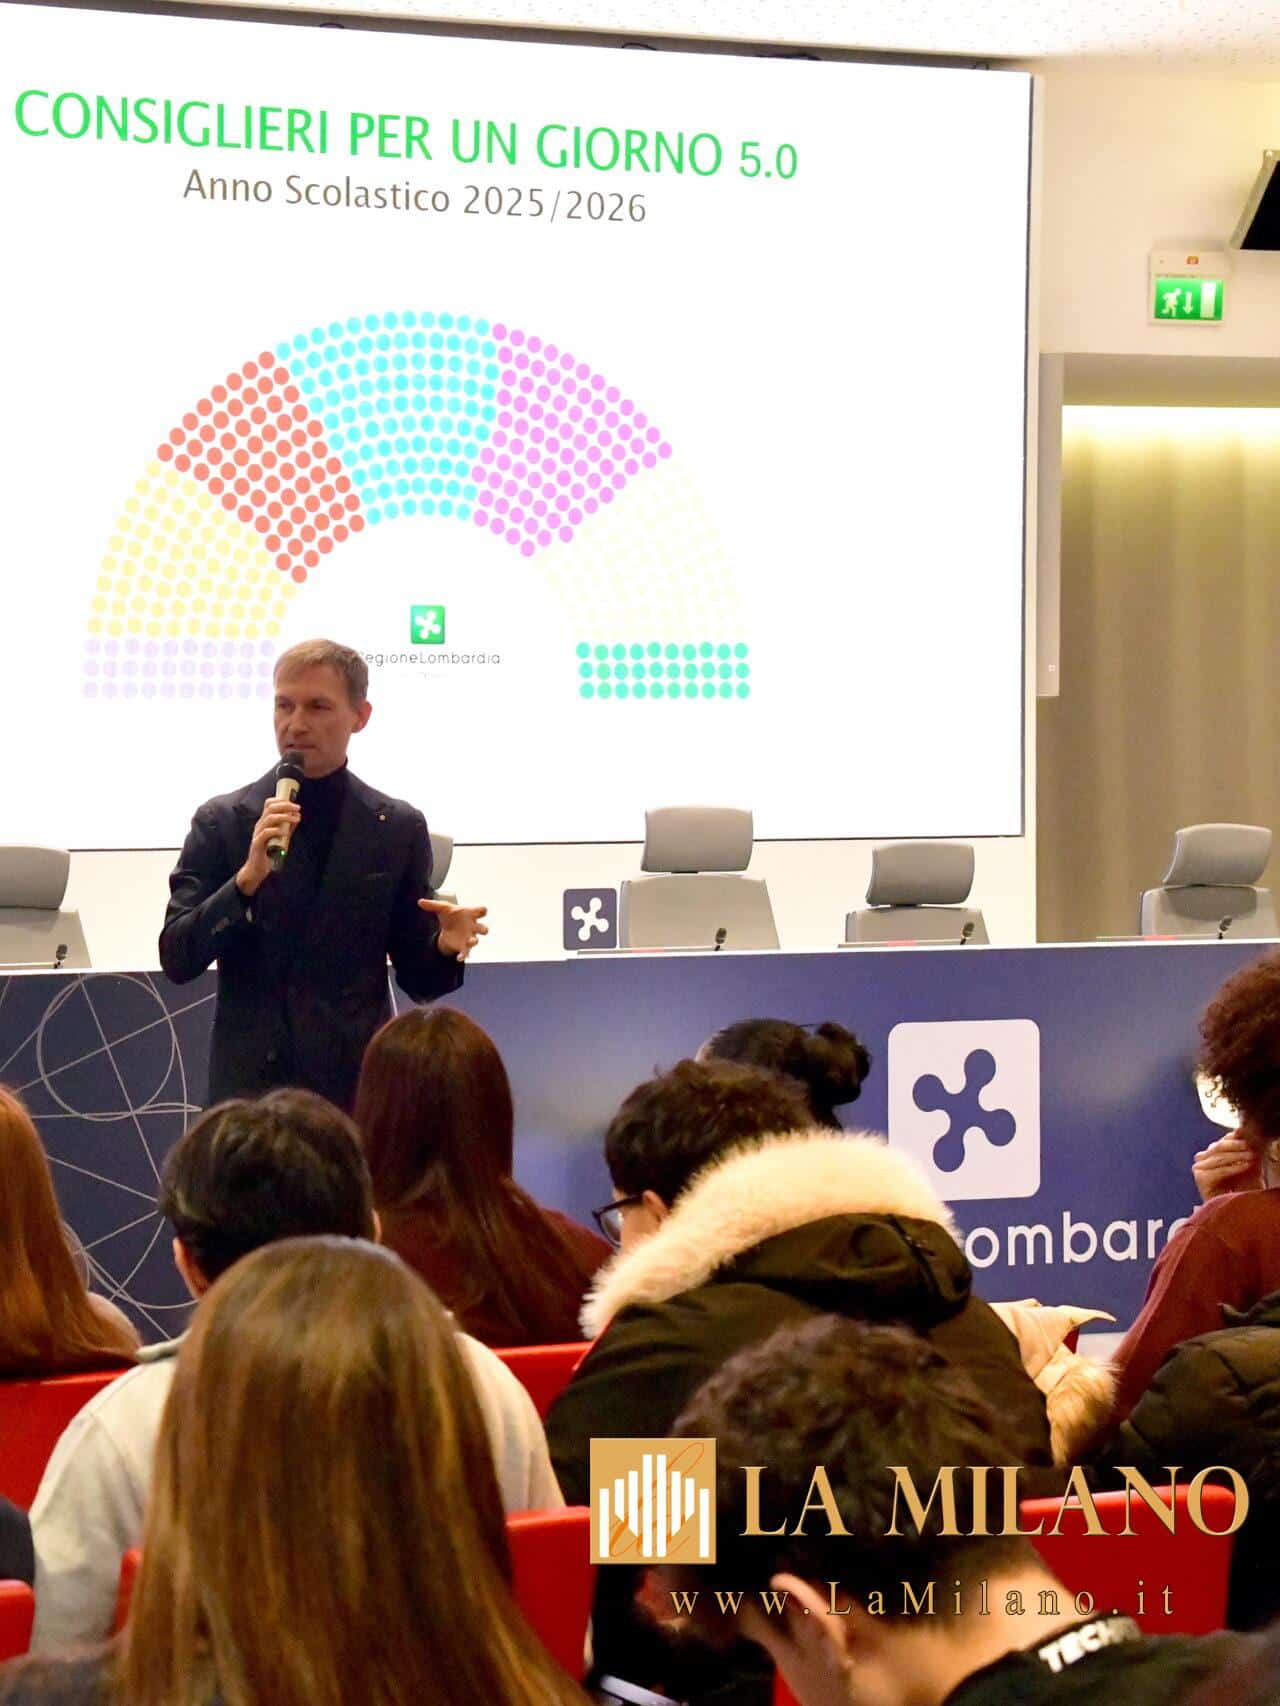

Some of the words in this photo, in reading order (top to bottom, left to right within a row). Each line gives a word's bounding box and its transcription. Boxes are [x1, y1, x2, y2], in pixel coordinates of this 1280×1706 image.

[15, 89, 327, 154] CONSIGLIERI
[350, 112, 432, 160] PER
[452, 118, 517, 166] UN
[536, 124, 722, 177] GIORNO
[739, 140, 798, 180] 5.0
[183, 169, 273, 203] Anno
[285, 174, 450, 213] Scolastico
[463, 184, 646, 223] 2025/2026
[964, 1205, 1196, 1269] ombar
